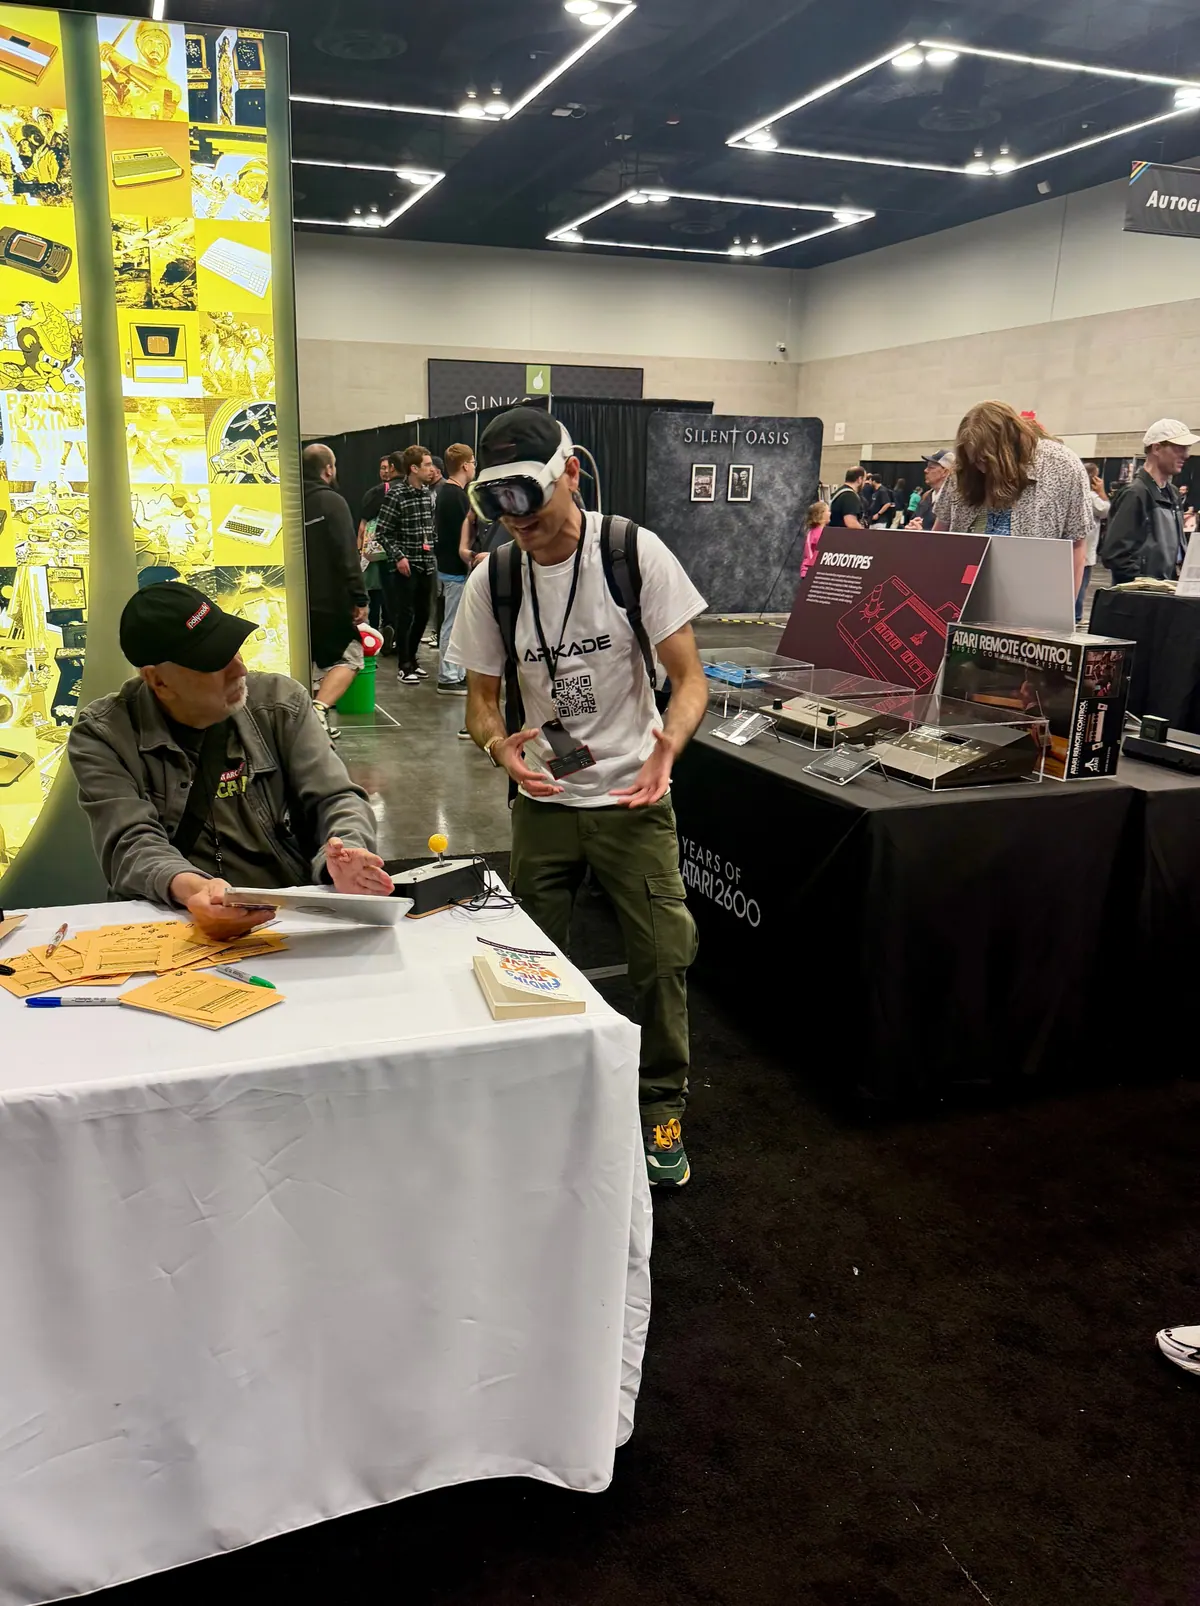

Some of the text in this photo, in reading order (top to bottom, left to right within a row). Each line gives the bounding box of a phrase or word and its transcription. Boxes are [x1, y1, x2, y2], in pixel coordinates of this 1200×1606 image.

[1146, 190, 1200, 213] AUTOG
[464, 395, 532, 411] GINK
[684, 424, 790, 450] SILENT OASIS
[820, 551, 873, 570] PROTOTYPES
[951, 645, 977, 655] VIDEO
[1035, 660, 1073, 673] SYSTEM
[952, 630, 1073, 666] ATARI REMOTE CONTROL
[681, 835, 742, 885] YEARS OF
[681, 858, 761, 927] ATARI 2600
